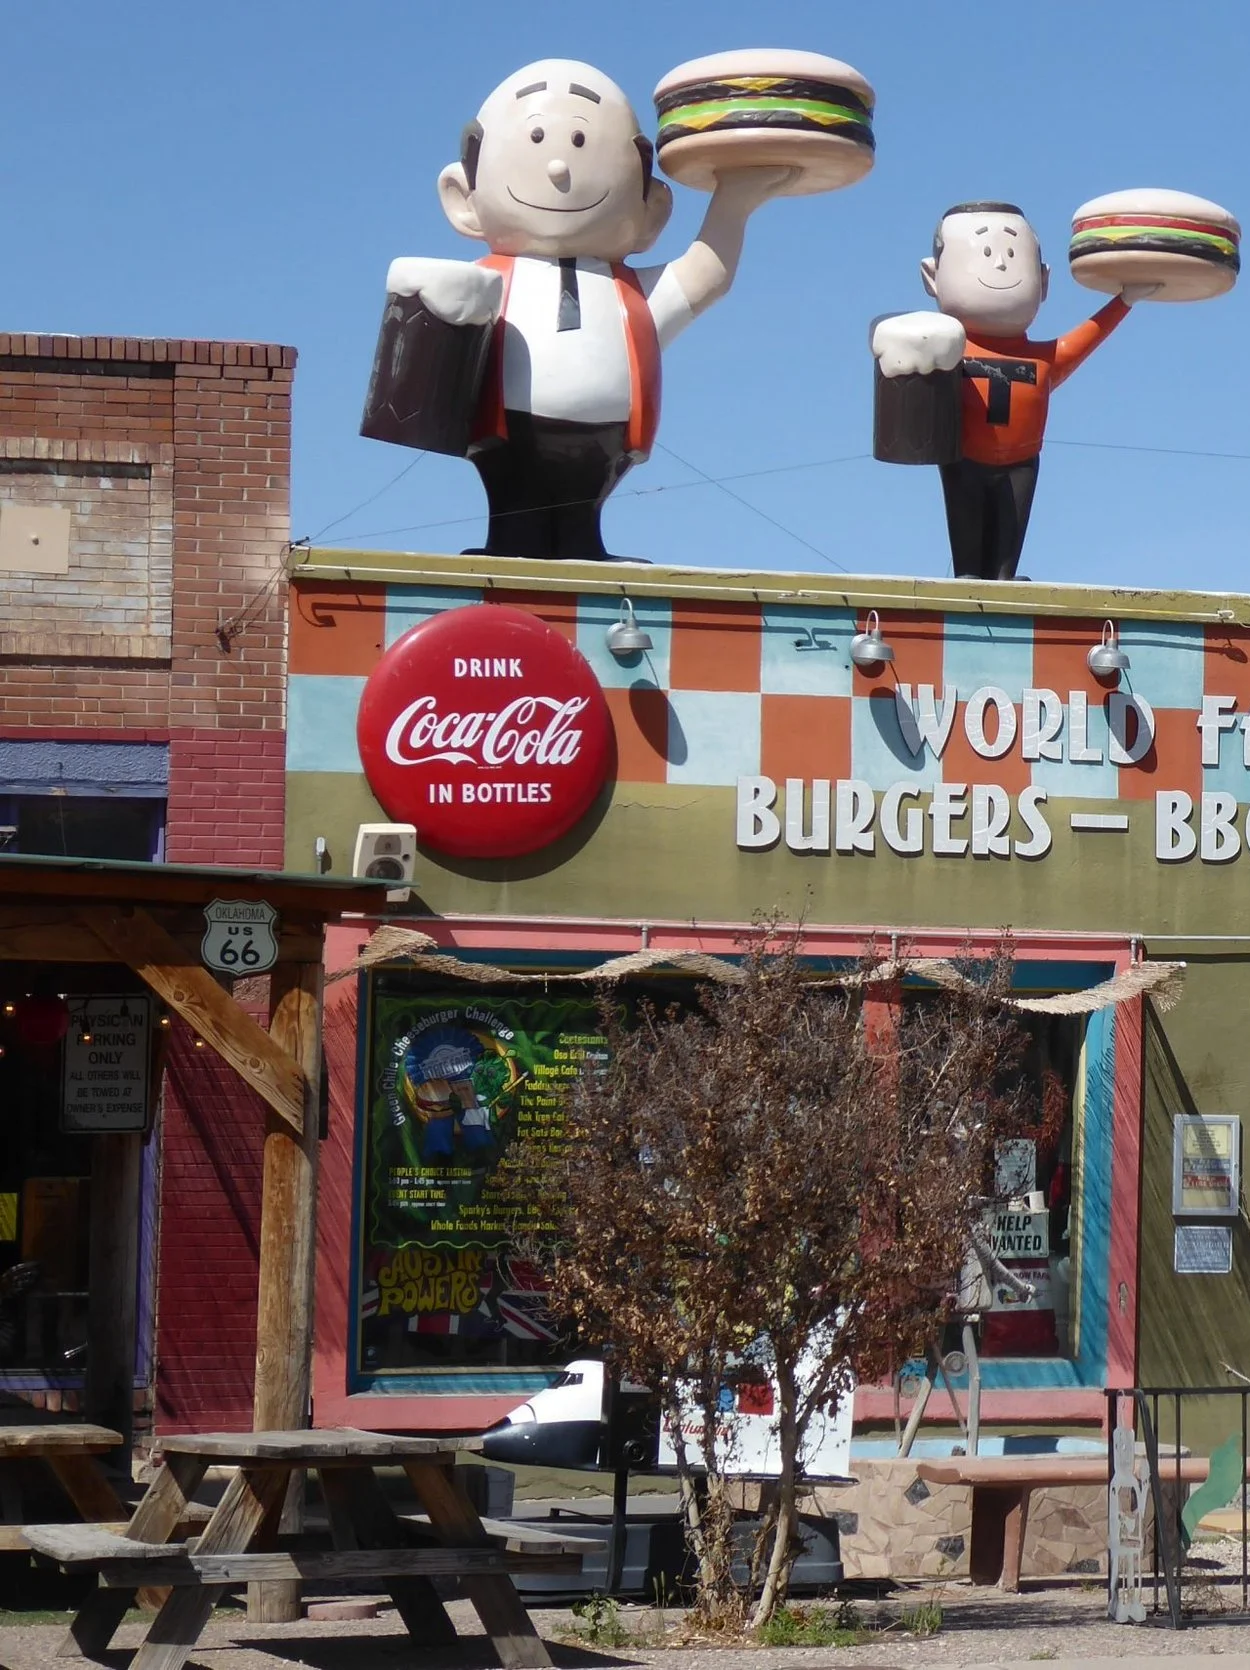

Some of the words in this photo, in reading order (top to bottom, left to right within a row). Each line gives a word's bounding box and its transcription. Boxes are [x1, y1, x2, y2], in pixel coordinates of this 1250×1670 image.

[454, 657, 523, 678] DRINK
[385, 694, 591, 766] Coca-Cola
[895, 683, 1155, 764] WORLD
[429, 783, 452, 803] IN
[462, 782, 552, 803] BOTTLES
[736, 775, 1053, 858] BURGERS
[215, 906, 265, 920] OKLAHOMA
[228, 926, 253, 936] US
[220, 939, 260, 965] 66
[392, 1009, 459, 1057] Cheeseburger
[465, 1005, 515, 1041] Challenge
[76, 1033, 136, 1046] PRKING
[88, 1051, 124, 1065] ONLY
[70, 1070, 82, 1080] ALL
[87, 1070, 119, 1080] OTHERS
[122, 1070, 141, 1080] WILL
[77, 1087, 88, 1097] BE
[91, 1087, 120, 1098] TOWED
[122, 1087, 133, 1097] AT
[106, 1103, 143, 1113] EXPENSE
[459, 1205, 491, 1218] Sparky's
[431, 1220, 453, 1231] Whole
[455, 1220, 478, 1231] Foods
[996, 1215, 1032, 1231] HELP
[378, 1249, 482, 1286] AUSTIN
[377, 1270, 480, 1317] POWERS
